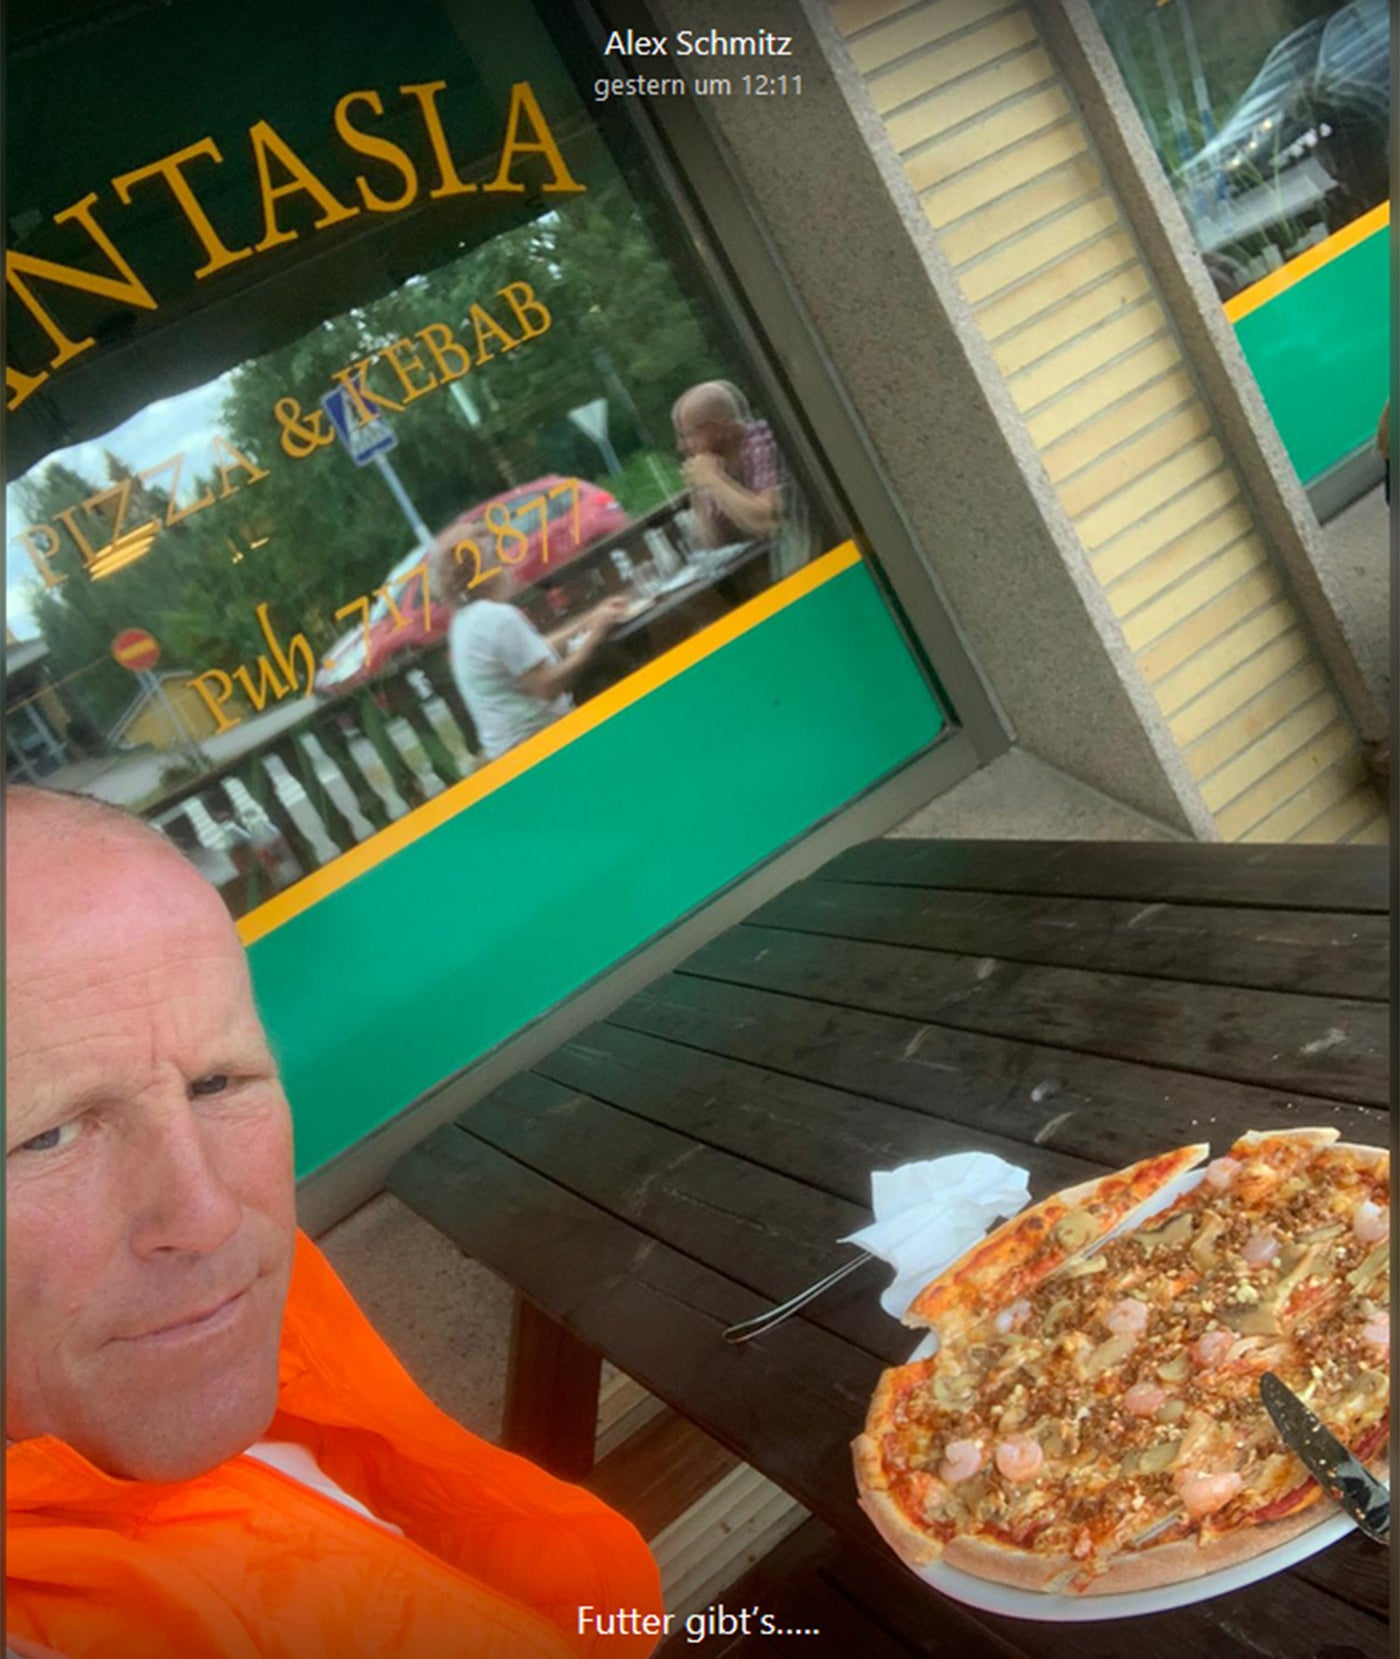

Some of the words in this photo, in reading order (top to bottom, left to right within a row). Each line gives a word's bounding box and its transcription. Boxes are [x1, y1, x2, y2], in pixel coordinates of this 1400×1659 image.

[11, 433, 270, 591] PIZZA
[273, 396, 335, 459] &
[331, 280, 553, 429] KEBAB
[334, 564, 432, 668] 717
[454, 478, 581, 590] 2877
